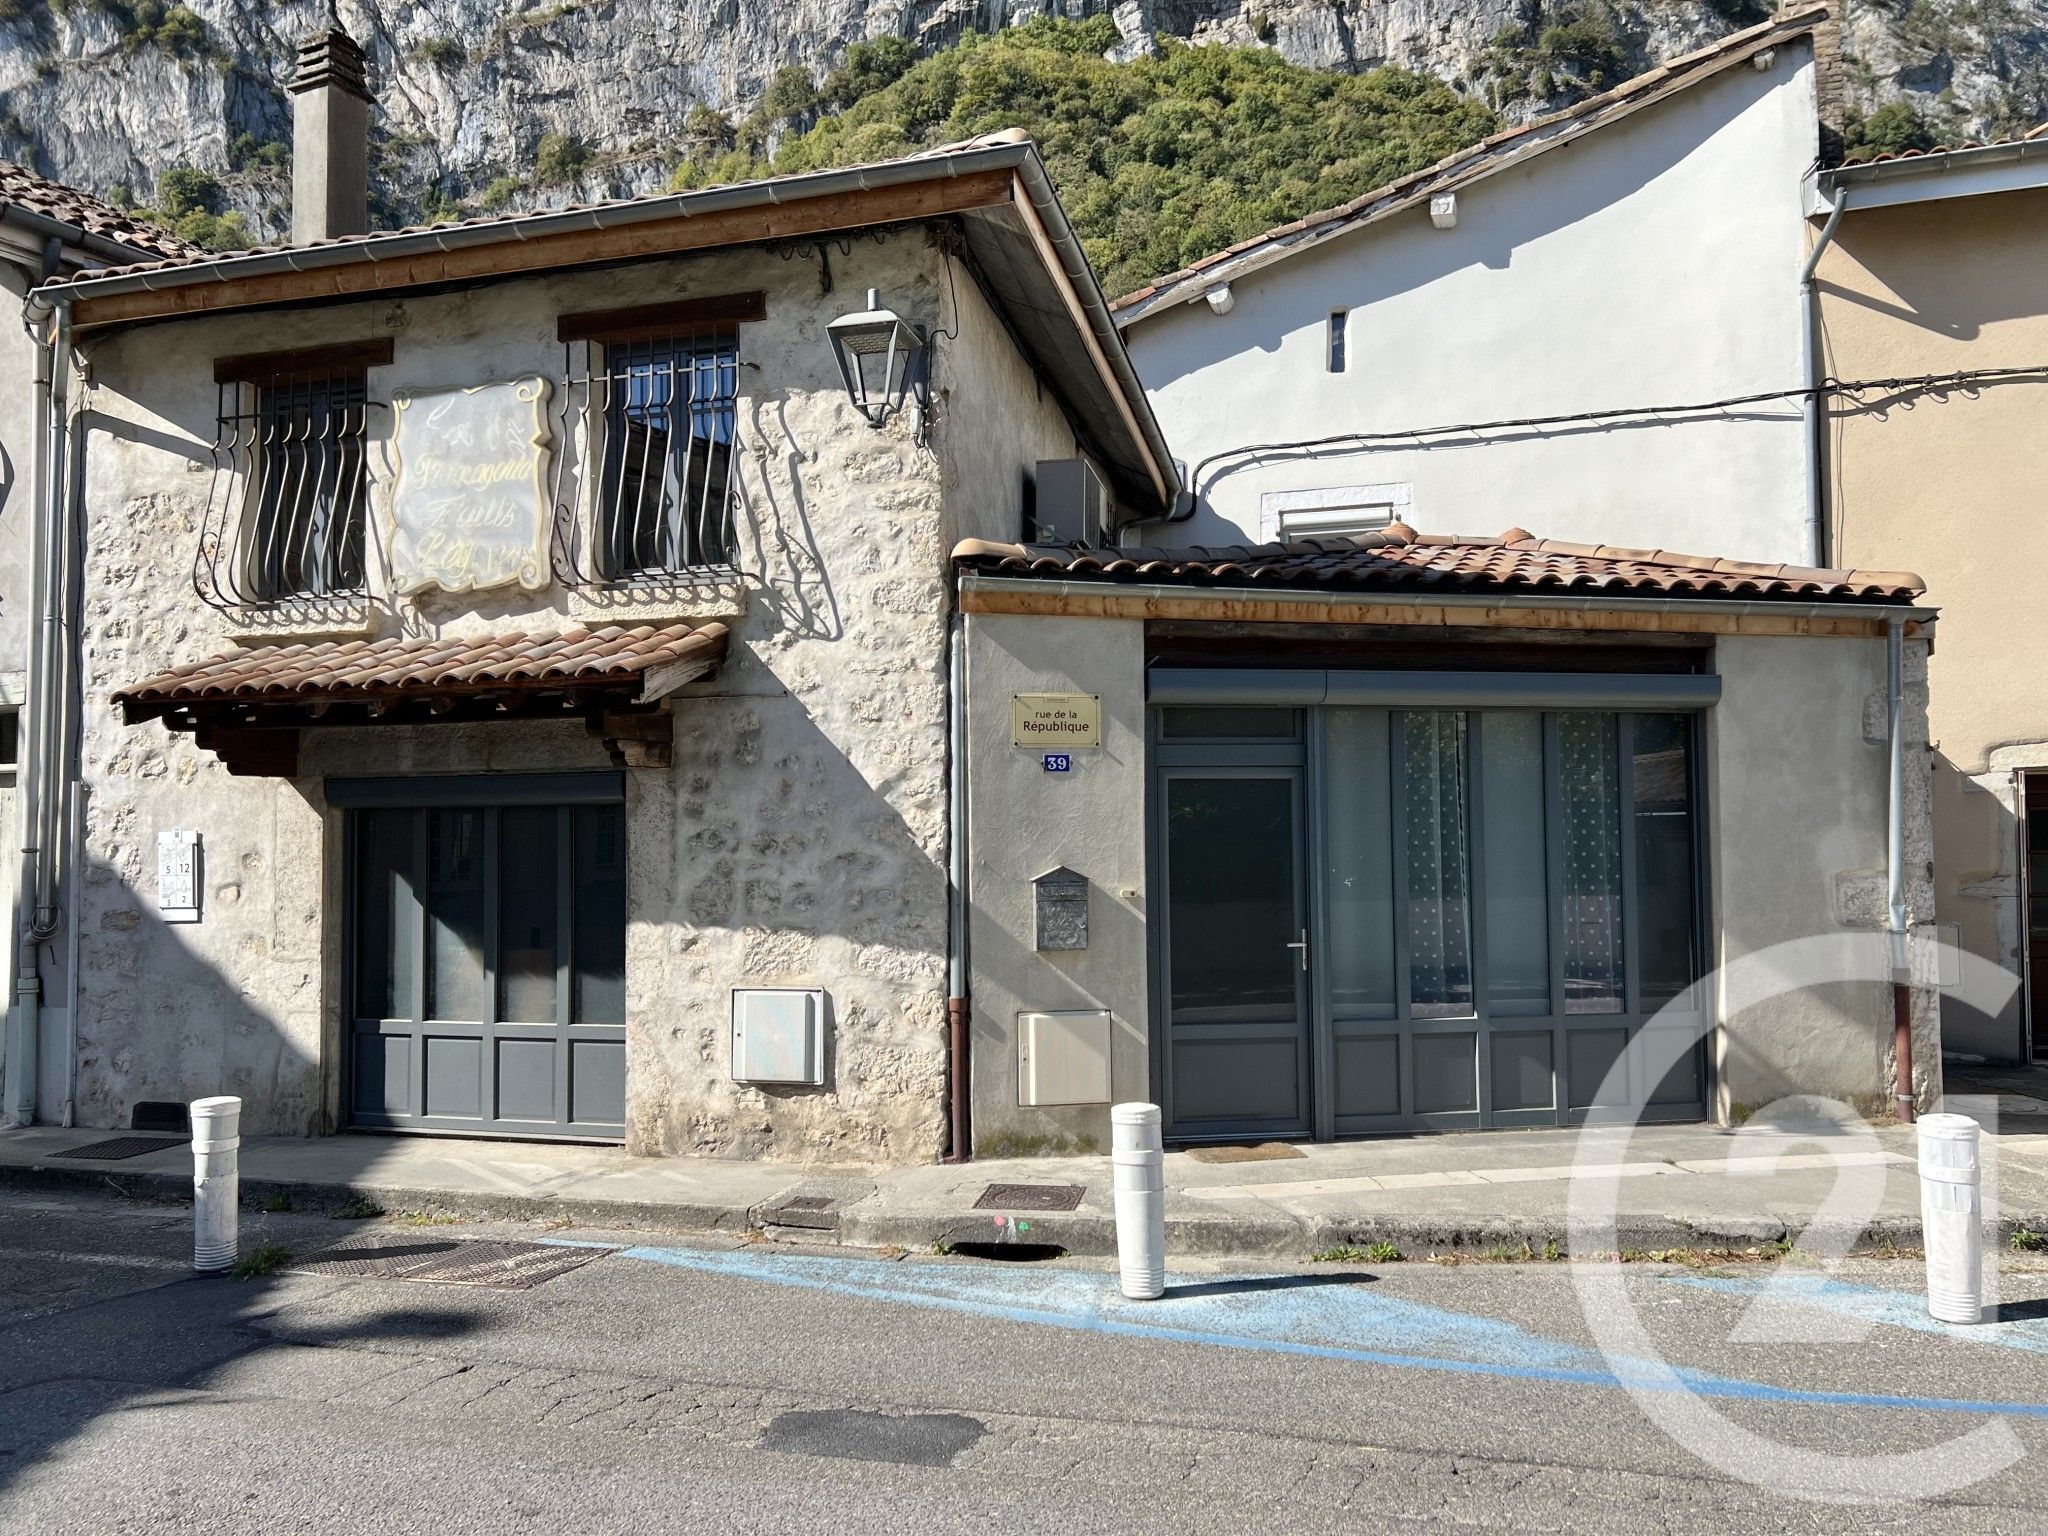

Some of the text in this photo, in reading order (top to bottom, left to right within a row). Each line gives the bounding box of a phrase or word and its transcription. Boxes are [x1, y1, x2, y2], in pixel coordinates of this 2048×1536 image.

[1035, 710, 1077, 719] rue de la
[1023, 720, 1089, 733] République
[1047, 757, 1067, 770] 39
[179, 863, 190, 873] 12
